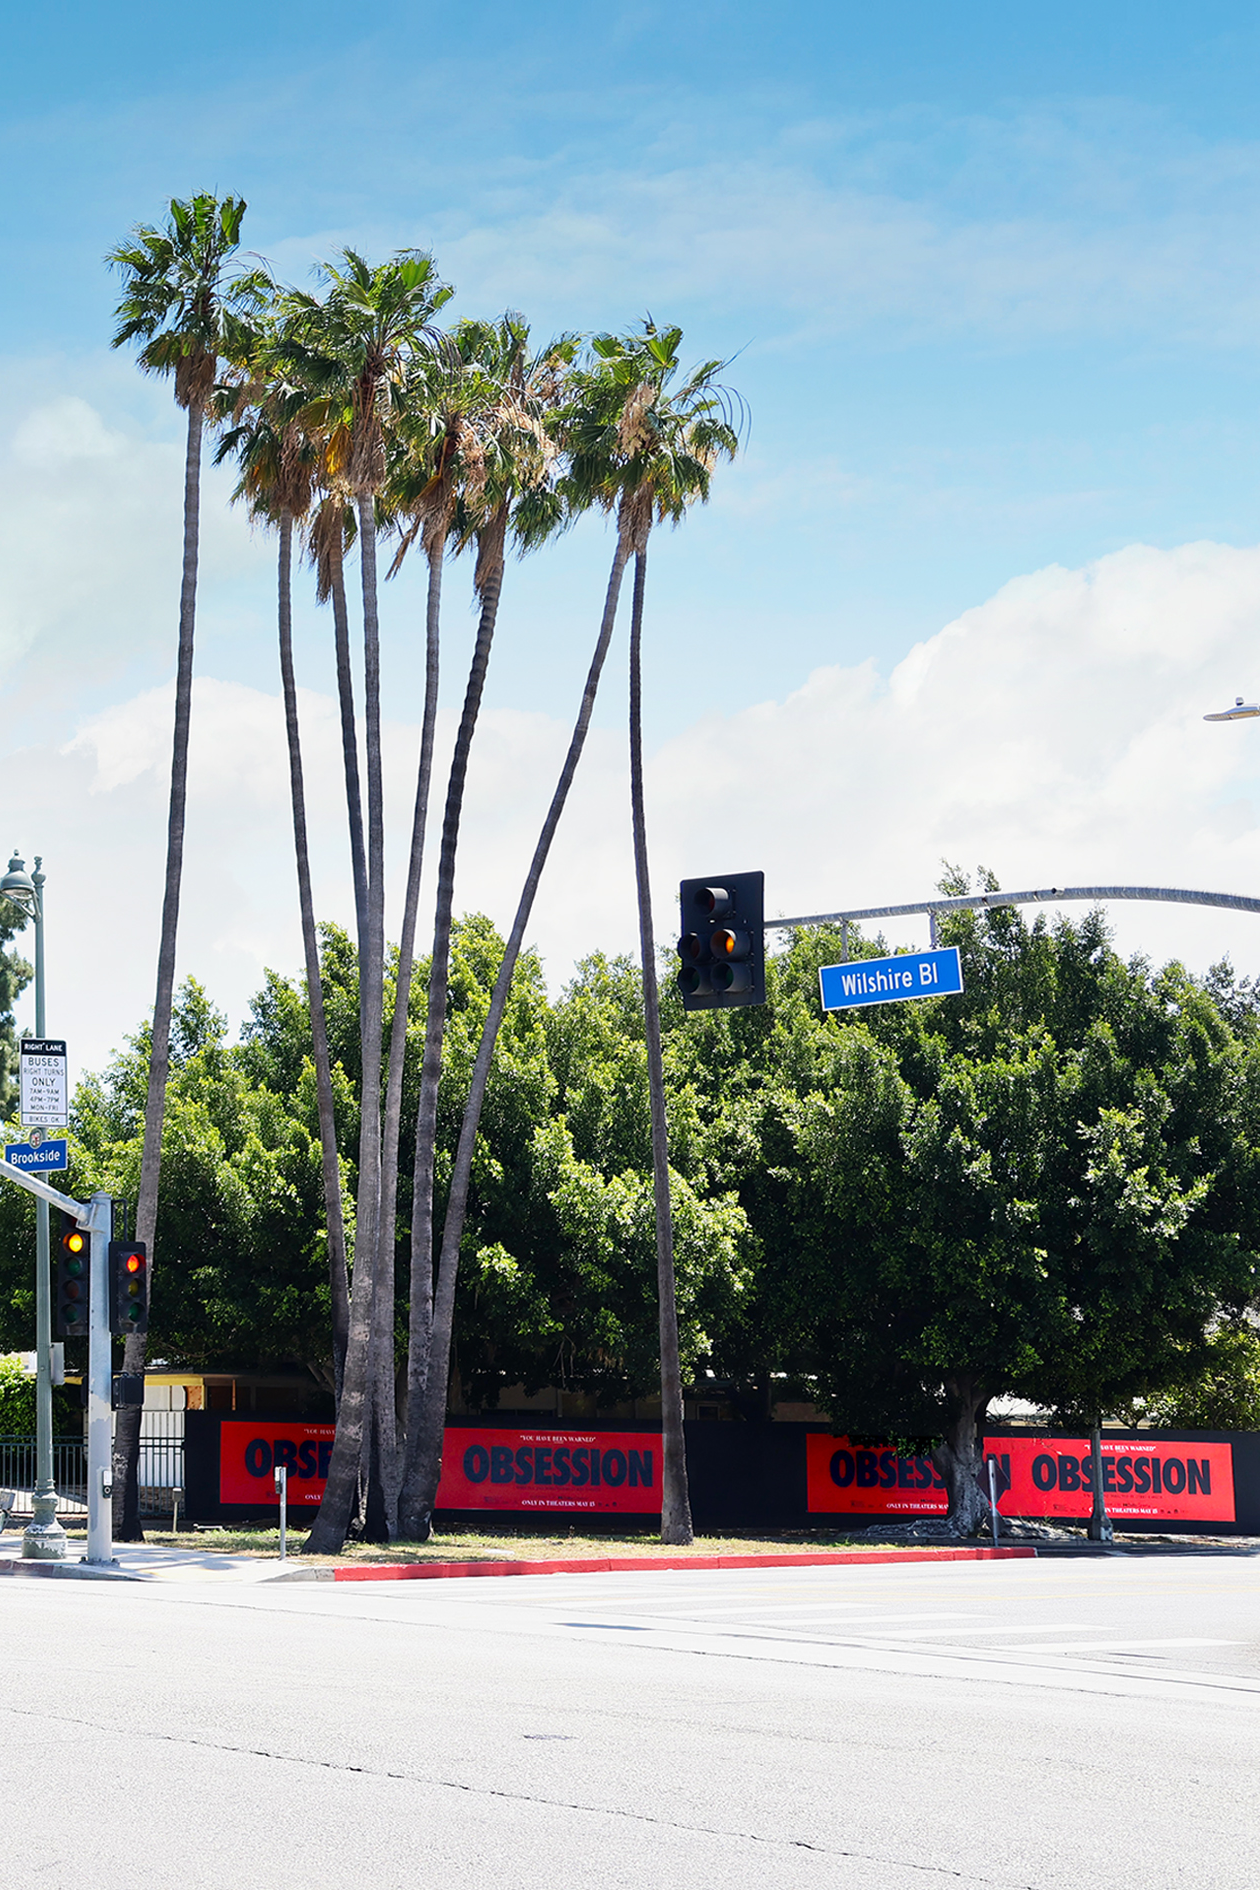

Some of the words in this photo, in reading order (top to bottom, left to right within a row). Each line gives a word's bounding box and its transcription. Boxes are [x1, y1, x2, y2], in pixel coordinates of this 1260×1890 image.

[842, 968, 913, 996] Wilshire
[919, 962, 938, 985] Bl
[24, 1043, 43, 1051] RIGHT
[45, 1044, 63, 1052] LANE
[28, 1056, 60, 1067] BUSES
[24, 1067, 41, 1075] RIGHT
[44, 1068, 65, 1076] TURNS
[31, 1077, 56, 1087] ONLY
[11, 1149, 61, 1165] Brookside
[463, 1444, 653, 1488] OBSESSION
[1032, 1453, 1212, 1495] OBSESSION
